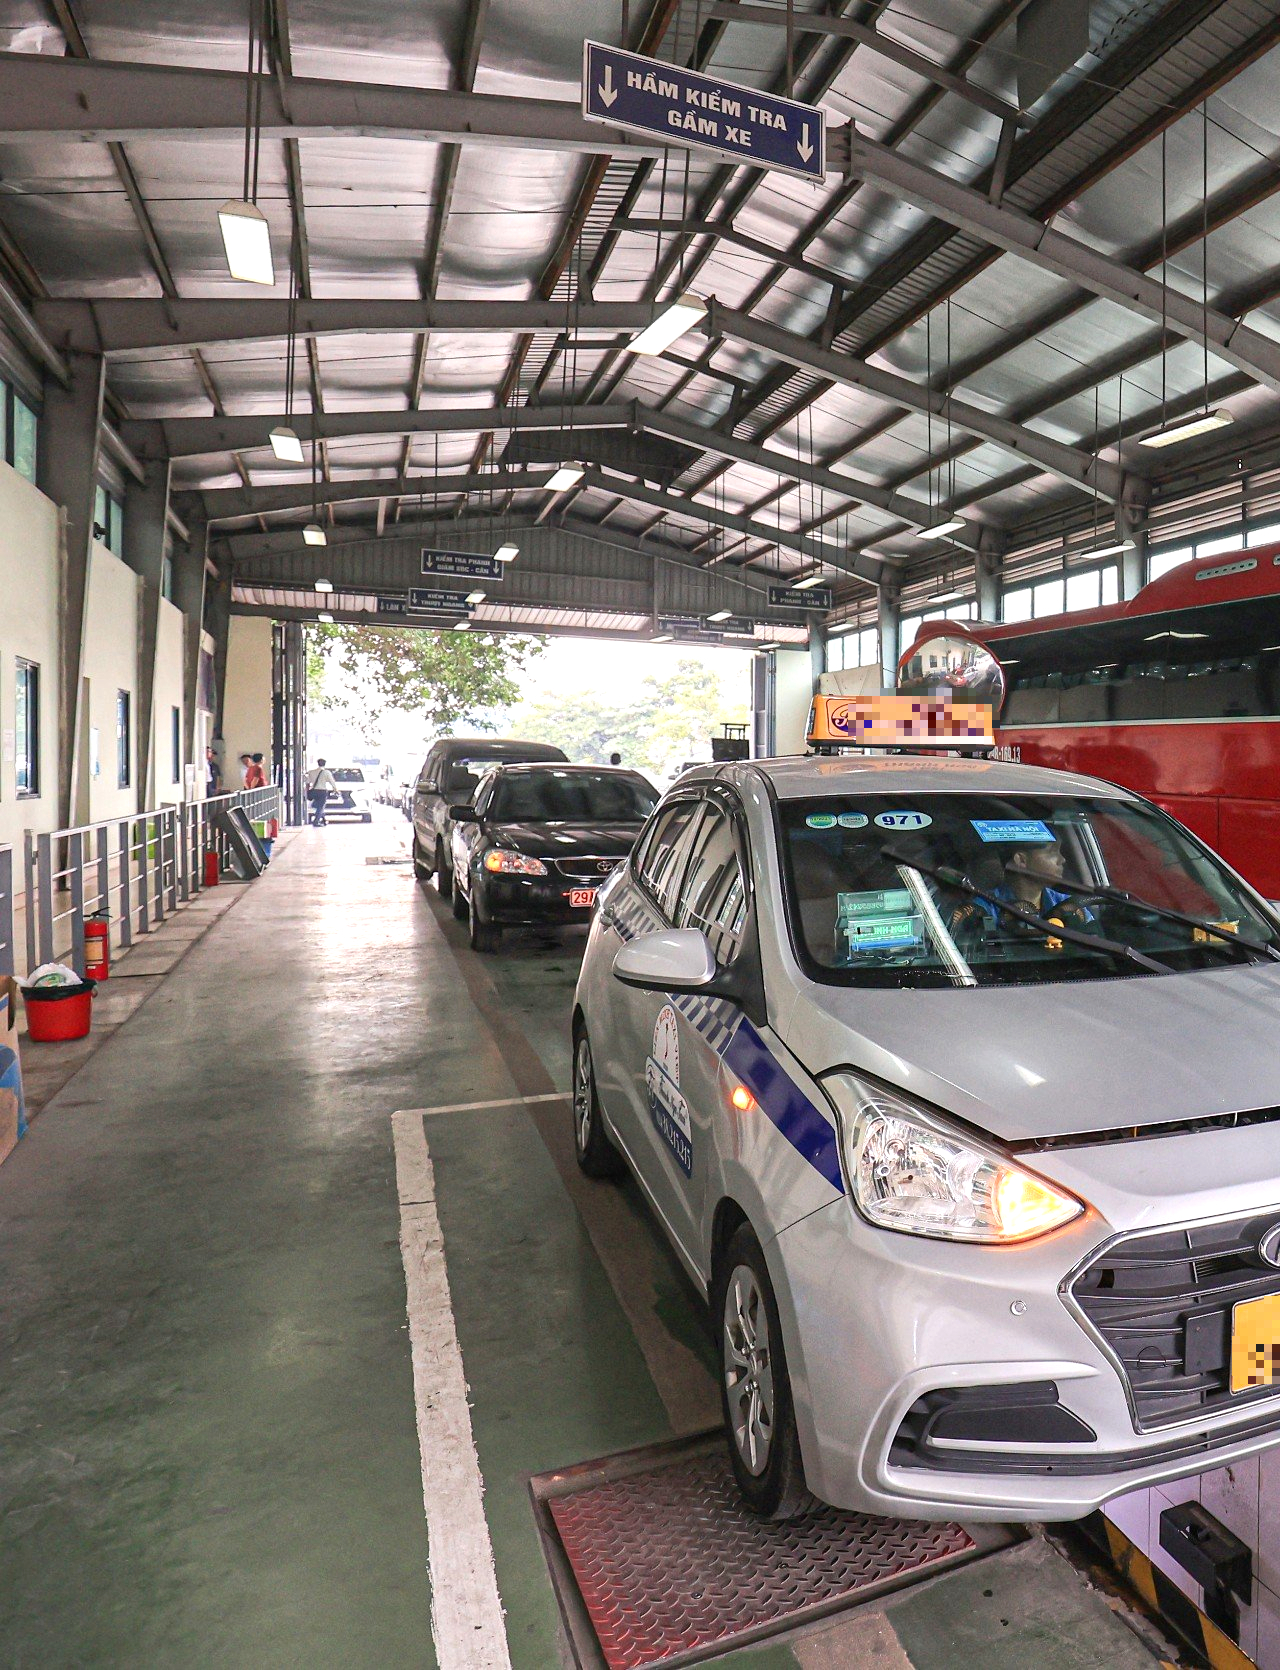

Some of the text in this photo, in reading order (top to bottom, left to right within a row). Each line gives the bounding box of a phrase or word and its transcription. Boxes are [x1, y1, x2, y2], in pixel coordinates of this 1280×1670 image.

[627, 70, 788, 131] HẦM KIỂM TRA
[668, 109, 752, 147] GẦM XE
[882, 815, 922, 825] 971
